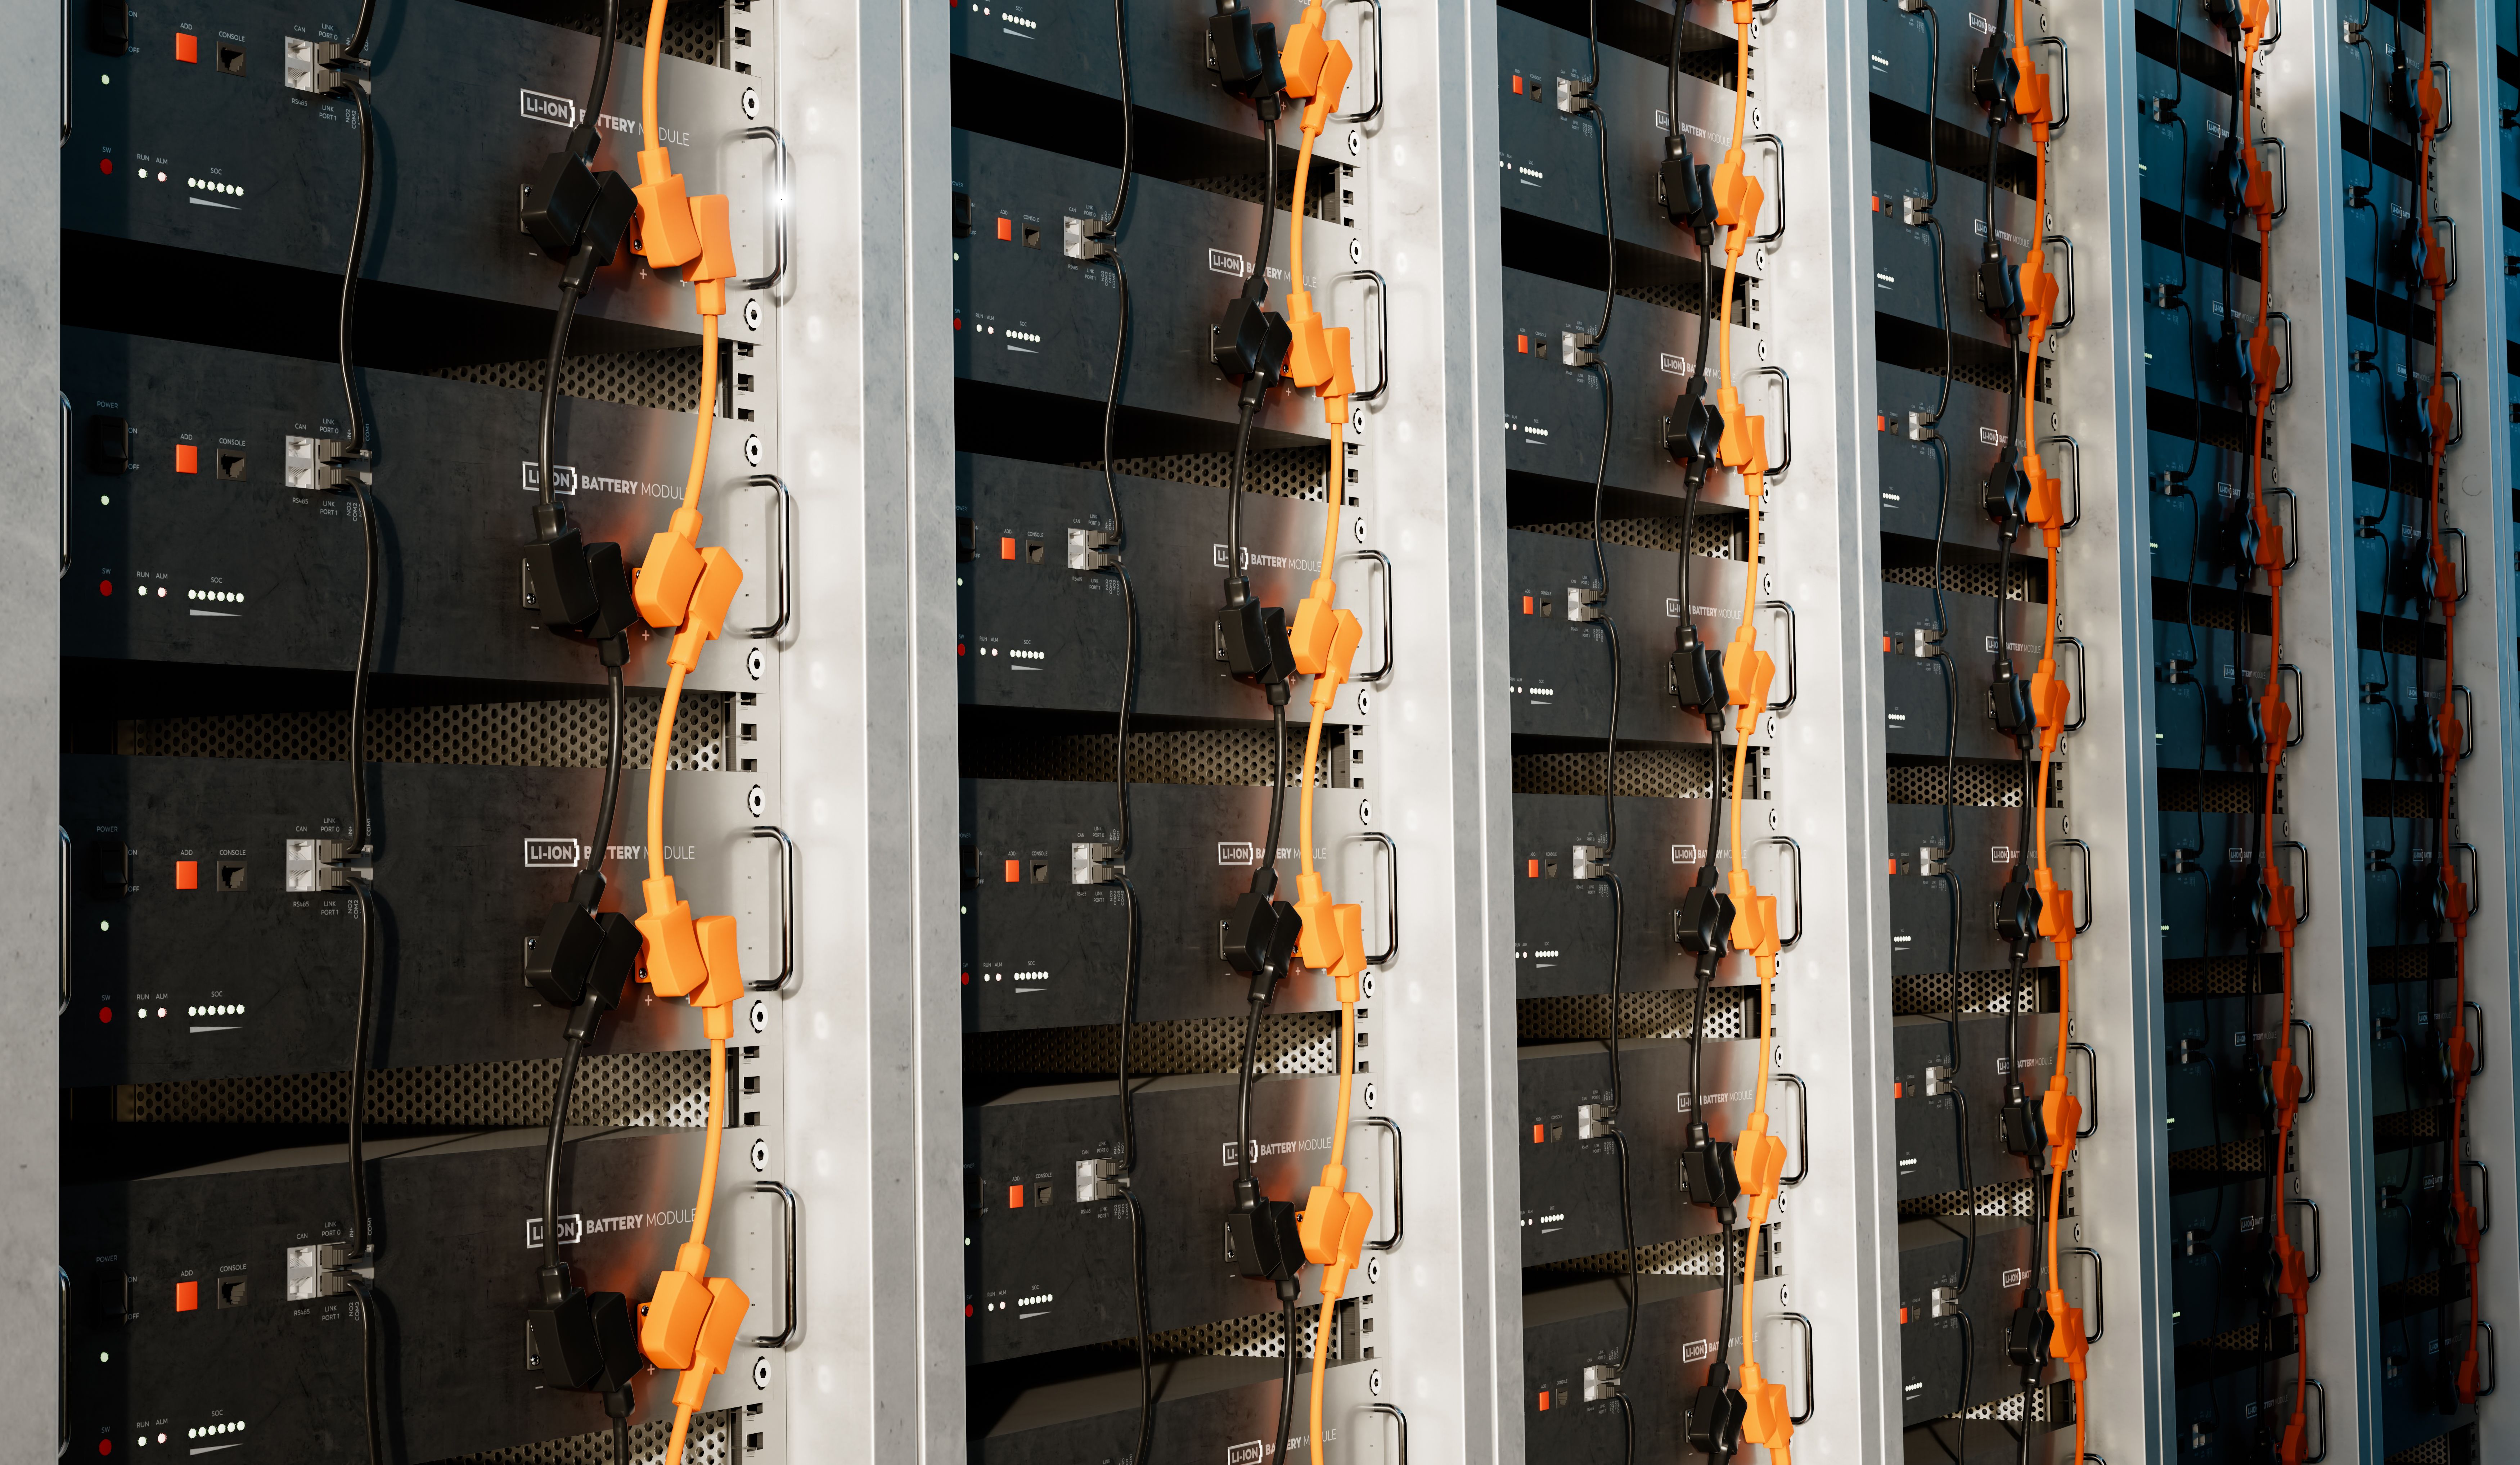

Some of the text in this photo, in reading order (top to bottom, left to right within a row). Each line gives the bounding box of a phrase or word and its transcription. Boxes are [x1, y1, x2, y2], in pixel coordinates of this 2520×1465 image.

[219, 31, 245, 42] CONSOLE
[292, 98, 307, 106] RS485
[527, 97, 567, 119] LI-ION
[579, 108, 636, 134] BTTERY
[1681, 122, 1731, 147] BATTERY MODULE
[2013, 235, 2030, 248] MODULE
[1213, 254, 1239, 271] LI-ION
[1664, 358, 1682, 370] LI-ION
[219, 438, 245, 446] CONSOLE
[1983, 431, 1996, 441] LI-ION
[582, 475, 638, 494] BATTERY
[641, 482, 688, 500] MODUL
[1251, 554, 1322, 572] BATTERY MODULE
[1692, 605, 1741, 619] BATTERY MODULE
[2024, 644, 2041, 654] MODULE
[531, 846, 572, 860] LI-ION
[1223, 848, 1248, 859] LI-ION
[1675, 849, 1693, 859] LI-ION
[2035, 1056, 2052, 1066] MODULE
[1703, 1090, 1752, 1104] BATTERY MODULE
[1261, 1137, 1331, 1156] BATTERY MODULE
[586, 1214, 643, 1234] BATTERY
[646, 1208, 696, 1227] MODULE
[220, 1263, 246, 1272] CONSOLE
[2005, 1273, 2019, 1283] LI-ION
[1686, 1345, 1704, 1358] LI-ION
[1232, 1447, 1258, 1463] LI-ION
